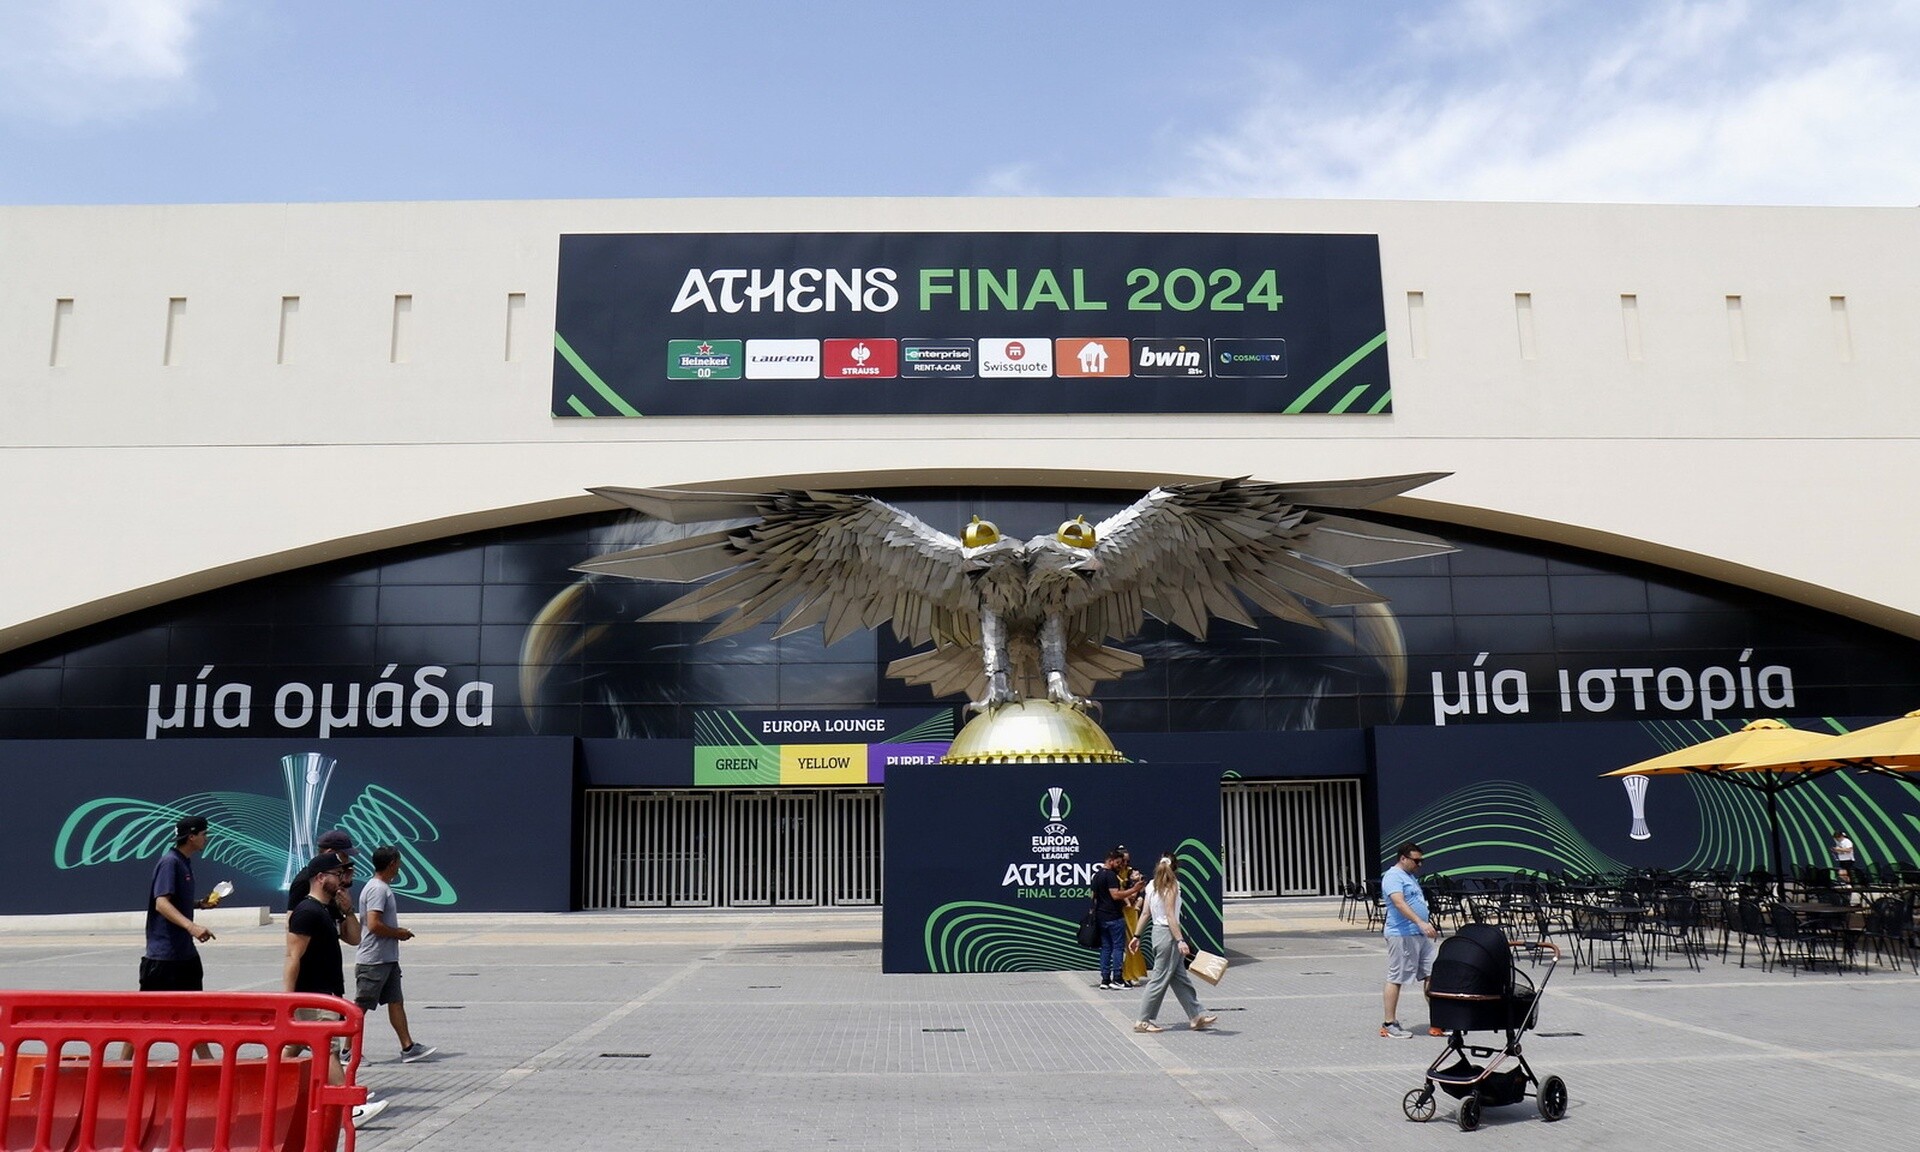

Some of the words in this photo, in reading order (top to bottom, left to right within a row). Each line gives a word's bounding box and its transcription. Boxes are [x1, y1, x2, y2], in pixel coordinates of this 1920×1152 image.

[671, 268, 899, 313] ATHENS
[919, 269, 1107, 311] FINAL
[1126, 268, 1283, 311] 2024
[911, 349, 969, 360] enterprise
[1139, 345, 1200, 367] bwin
[681, 357, 729, 366] Heineken
[984, 362, 1048, 373] Swissquote
[842, 367, 880, 375] STRAUSS
[1431, 652, 1530, 726] μία
[1558, 648, 1795, 721] ιστορία
[146, 665, 252, 740] μία
[274, 663, 494, 739] ομάδα
[762, 720, 822, 733] EUROPA
[825, 719, 886, 732] LOUNGE
[715, 758, 758, 771] GREEN
[797, 757, 851, 770] YELLOW
[1045, 824, 1067, 834] UEFA
[1032, 836, 1079, 846] EUROPA
[1018, 889, 1056, 899] FINAL
[1060, 888, 1092, 899] 2024
